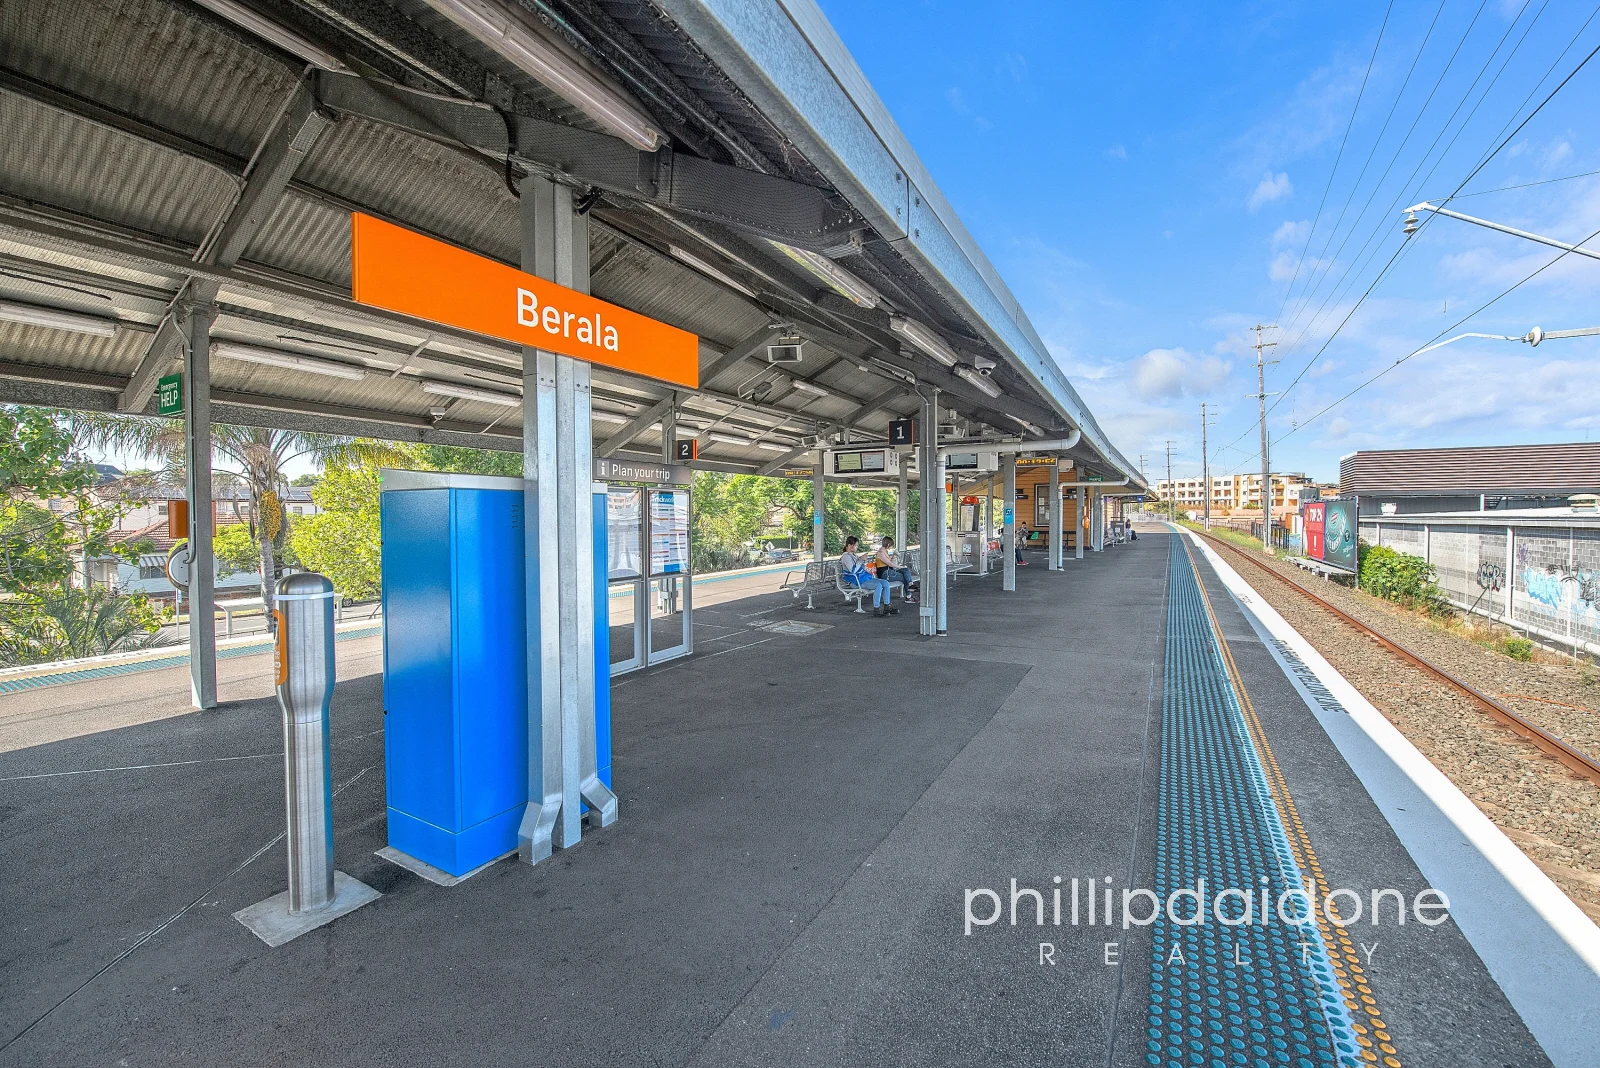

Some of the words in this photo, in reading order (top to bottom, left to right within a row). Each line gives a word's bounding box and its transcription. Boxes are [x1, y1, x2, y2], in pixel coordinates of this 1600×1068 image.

[516, 287, 619, 352] Berala
[161, 382, 178, 391] Emergency
[161, 390, 178, 408] HELP
[896, 425, 905, 439] 1
[681, 444, 689, 456] 2
[612, 464, 633, 477] Plan
[634, 467, 657, 479] your
[656, 467, 670, 481] trip
